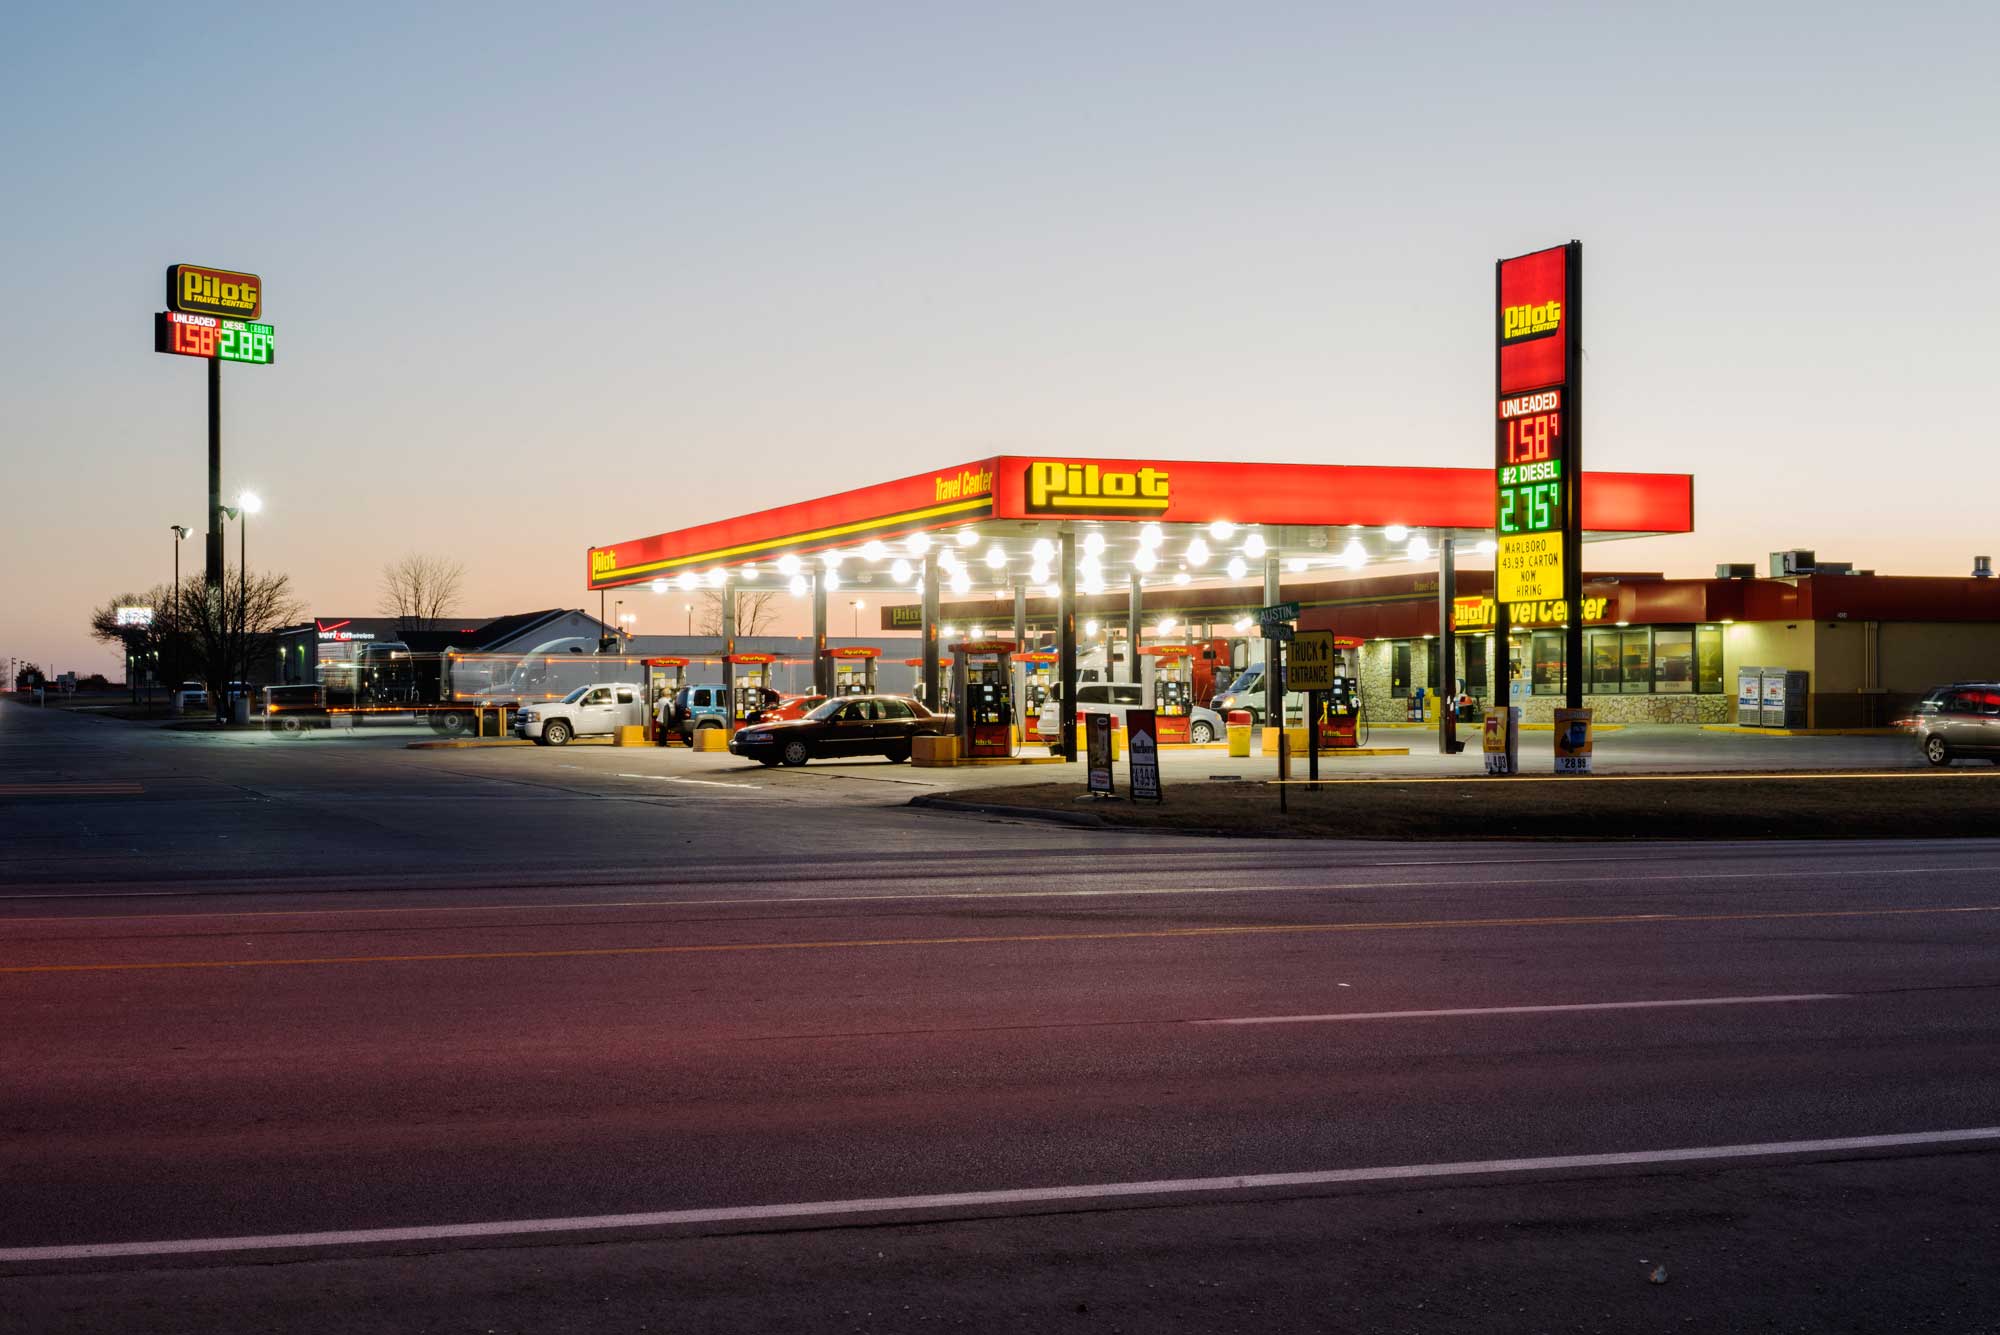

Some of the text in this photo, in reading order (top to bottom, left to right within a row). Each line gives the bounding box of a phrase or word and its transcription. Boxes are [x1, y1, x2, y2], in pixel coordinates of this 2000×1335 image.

[183, 271, 257, 303] Pilot
[193, 295, 254, 309] TRAVEL CENTERS
[172, 313, 216, 327] UNLEADED
[223, 320, 247, 331] DIESEL
[1504, 300, 1561, 339] Pilot
[1502, 392, 1557, 418] UNLEADED
[1502, 461, 1558, 484] #2 DIESEL
[935, 467, 993, 501] Travel Center
[1032, 462, 1168, 506] Pilot
[1505, 539, 1546, 554] MARLBORO
[592, 550, 616, 580] Pilot
[1503, 552, 1558, 569] 43.99 CARTON
[1521, 570, 1536, 582] NOW
[1516, 584, 1542, 597] HIRING
[1261, 606, 1292, 621] AUSTIN
[318, 631, 352, 641] verizon
[1290, 641, 1318, 662] TRUCK
[1290, 665, 1328, 683] ENTRANCE
